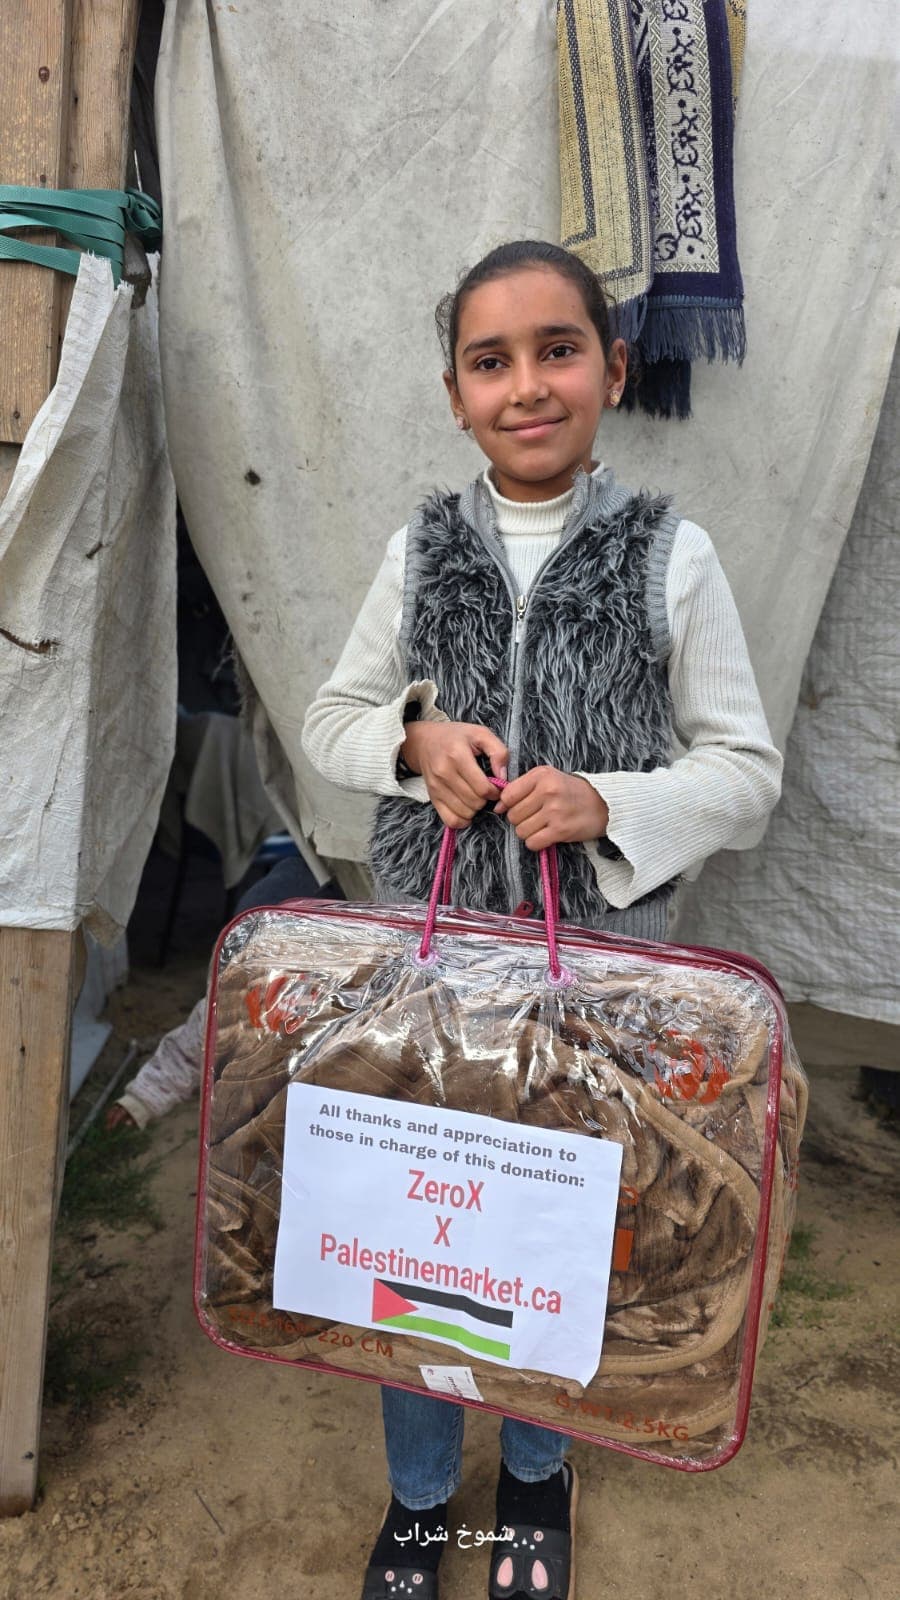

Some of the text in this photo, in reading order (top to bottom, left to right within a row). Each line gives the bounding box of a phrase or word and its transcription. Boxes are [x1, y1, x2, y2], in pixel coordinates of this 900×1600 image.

[309, 1123, 585, 1188] those in charge of this donation:
[319, 1103, 577, 1163] All thanks and appreciation to
[407, 1168, 485, 1212] ZeroX
[433, 1215, 453, 1248] X
[320, 1232, 562, 1315] Palestinemarket.ca
[361, 1337, 394, 1359] CM
